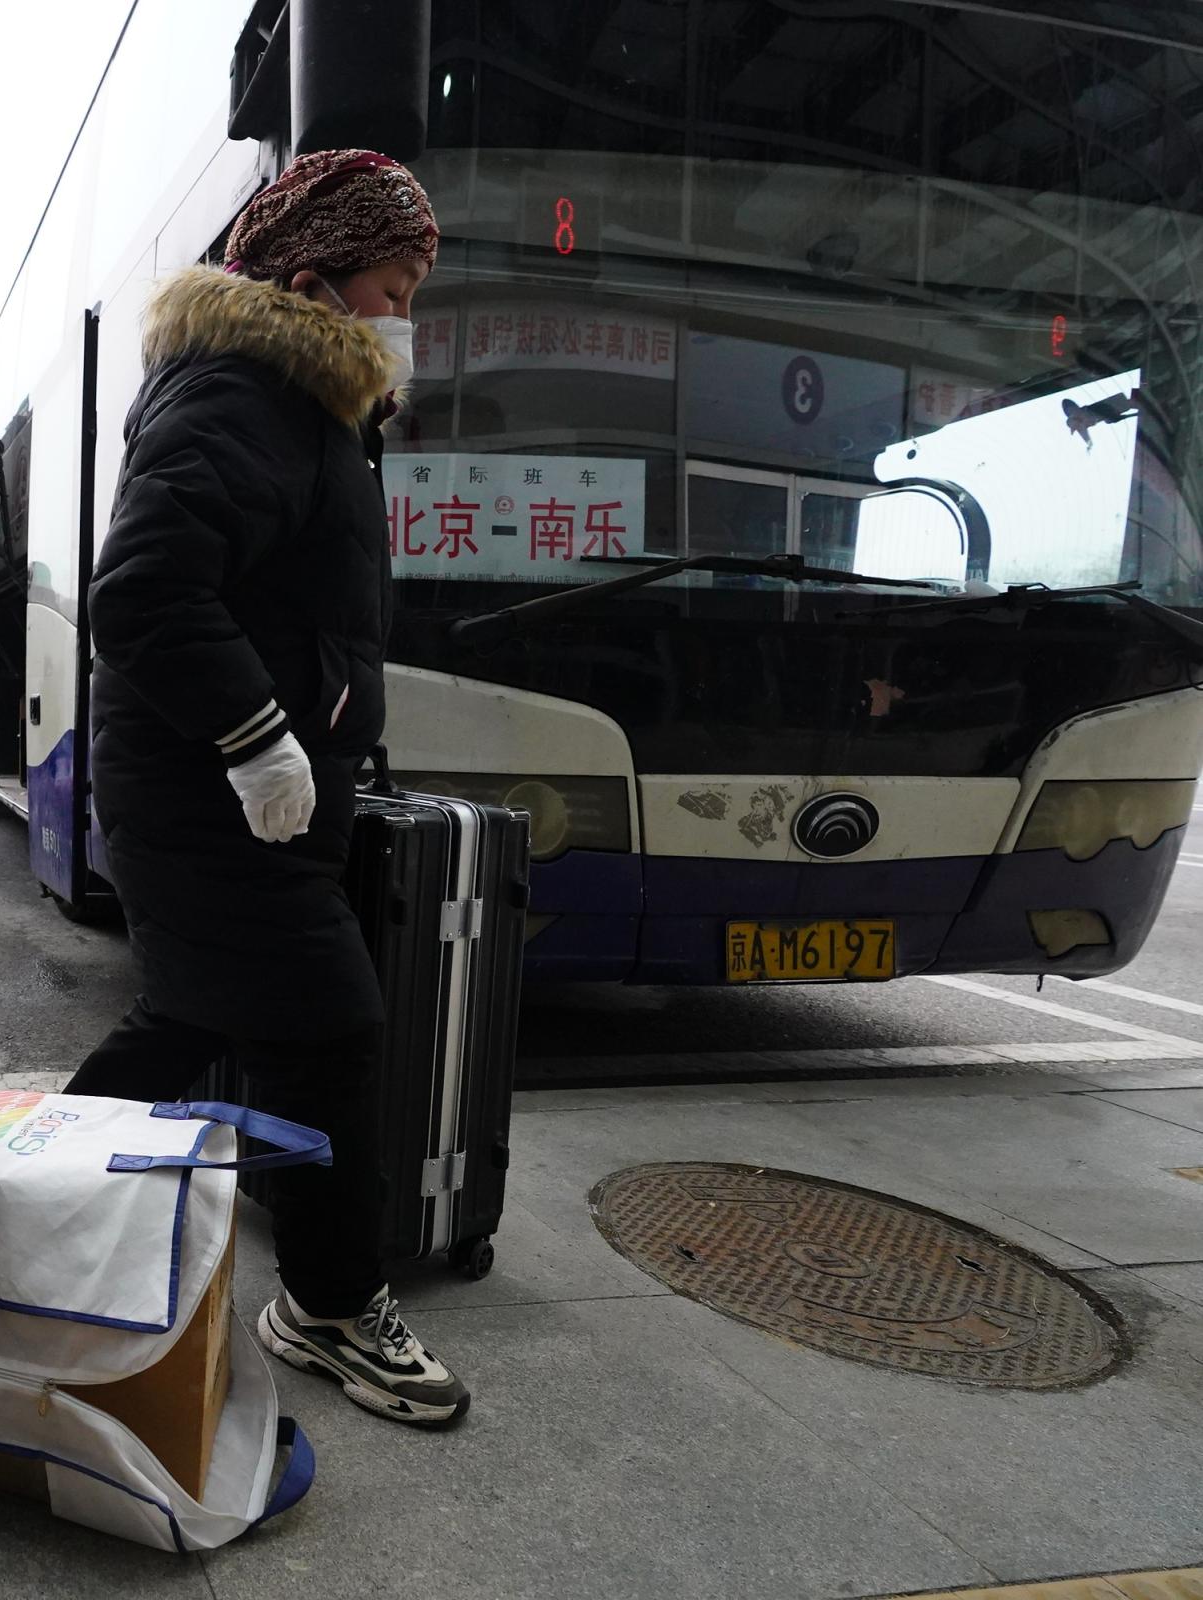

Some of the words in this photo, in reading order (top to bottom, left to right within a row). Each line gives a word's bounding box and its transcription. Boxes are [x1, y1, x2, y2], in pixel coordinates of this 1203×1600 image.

[555, 197, 574, 254] 8
[412, 465, 598, 489] 省际班车
